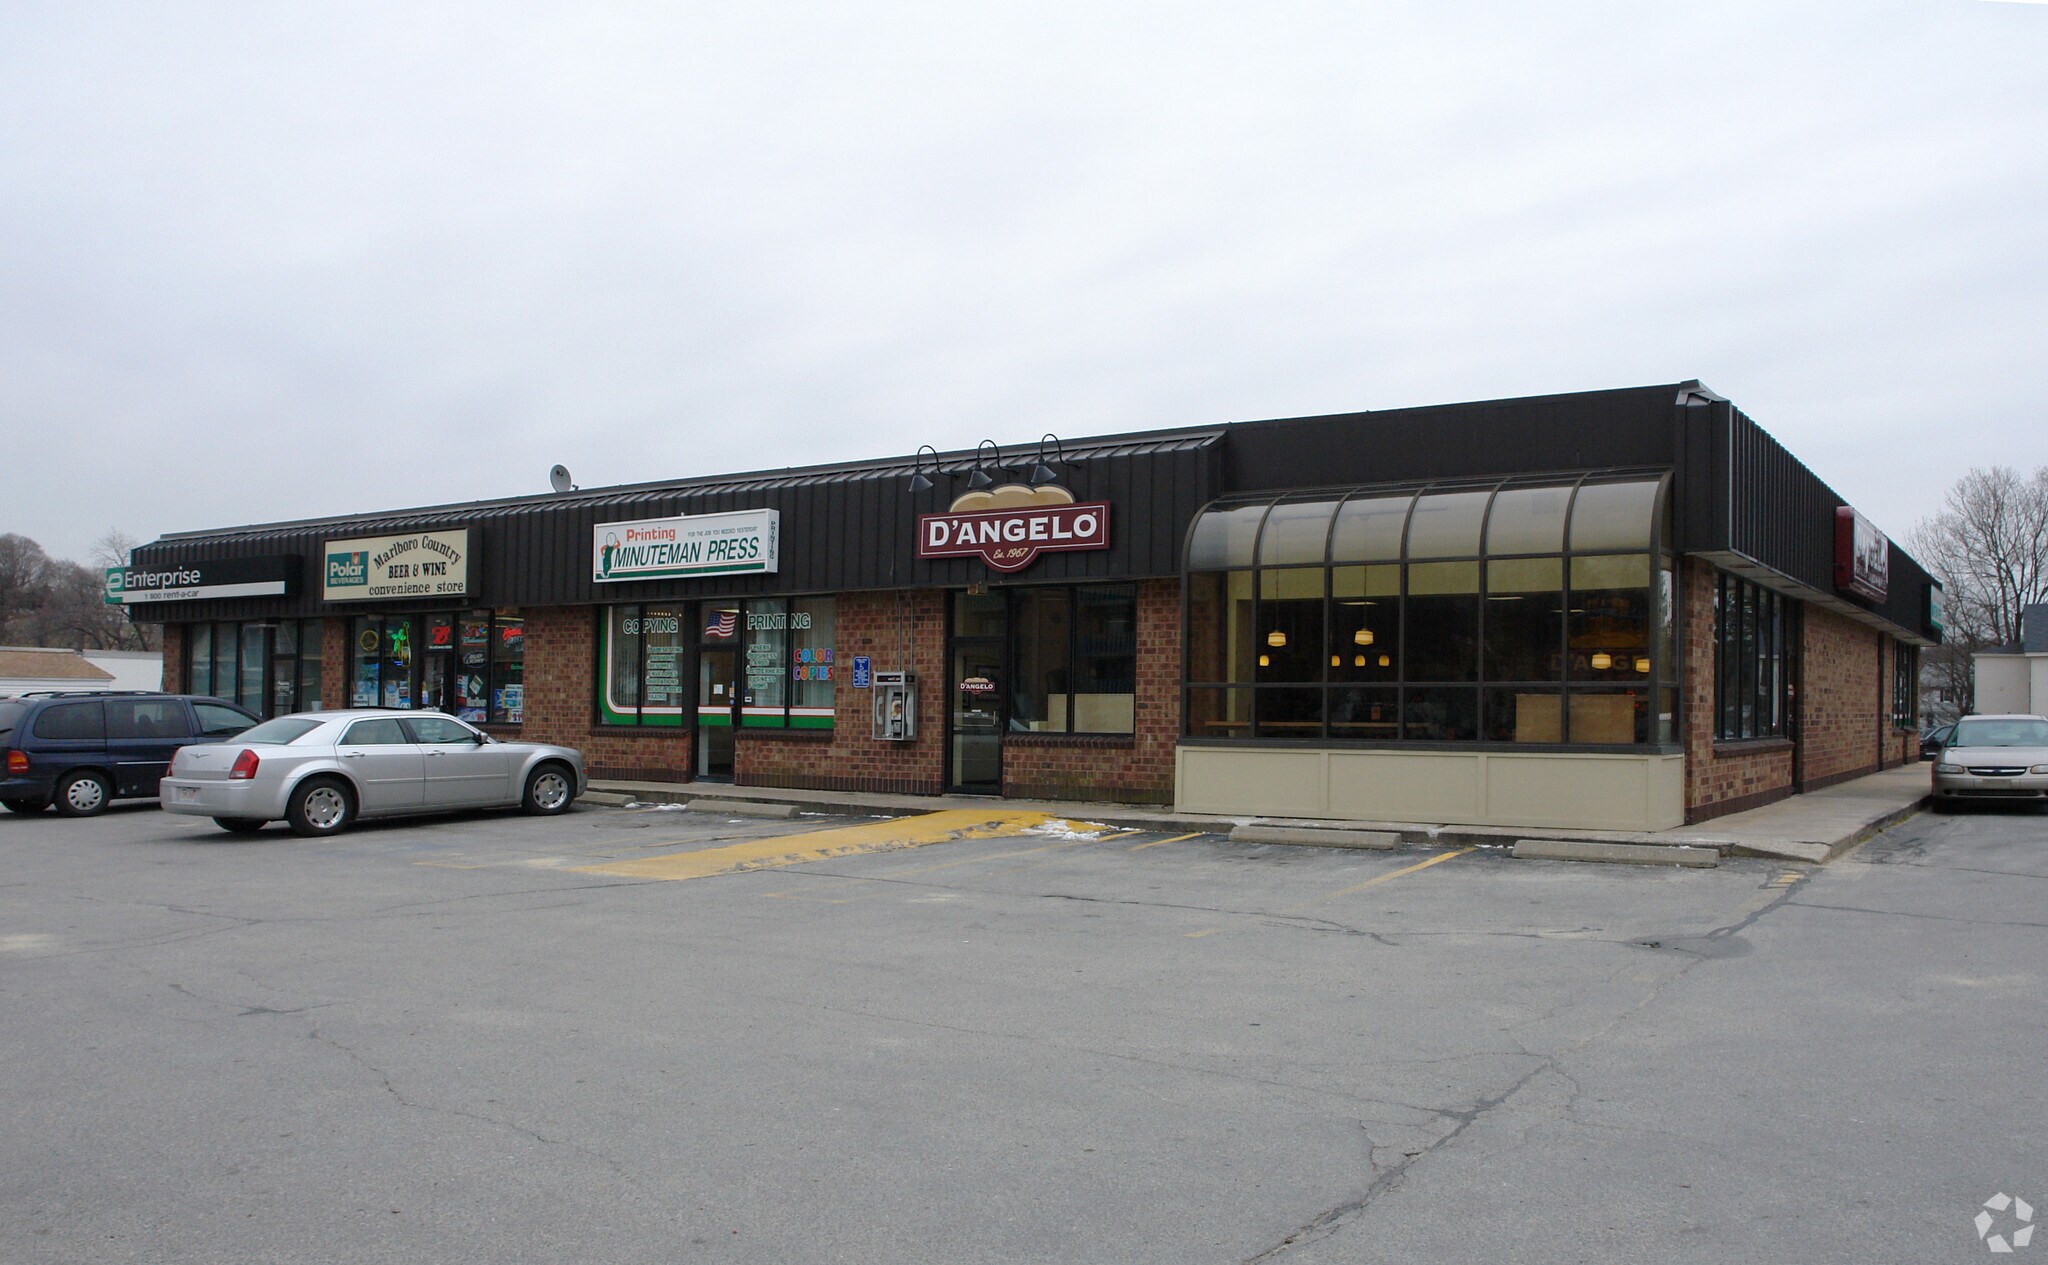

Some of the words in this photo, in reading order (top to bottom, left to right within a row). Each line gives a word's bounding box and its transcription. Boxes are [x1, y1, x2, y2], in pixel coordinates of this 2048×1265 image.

[626, 527, 676, 542] Printing
[928, 513, 1097, 547] D'ANGELO
[373, 539, 418, 570] Marlboro
[421, 535, 462, 566] Country
[614, 541, 702, 568] MINUTEMAN
[706, 536, 759, 561] PRESS
[1007, 547, 1029, 558] 1967
[330, 561, 364, 577] Polar
[388, 564, 410, 579] BEER
[422, 562, 447, 576] WINE
[124, 566, 201, 590] Enterprise
[163, 590, 200, 599] rent-a-car
[369, 582, 431, 595] convenience
[436, 582, 464, 592] store
[623, 617, 679, 634] COPYING
[747, 612, 812, 630] PRINTNG
[794, 648, 834, 663] COLOR
[793, 666, 834, 681] COPIES
